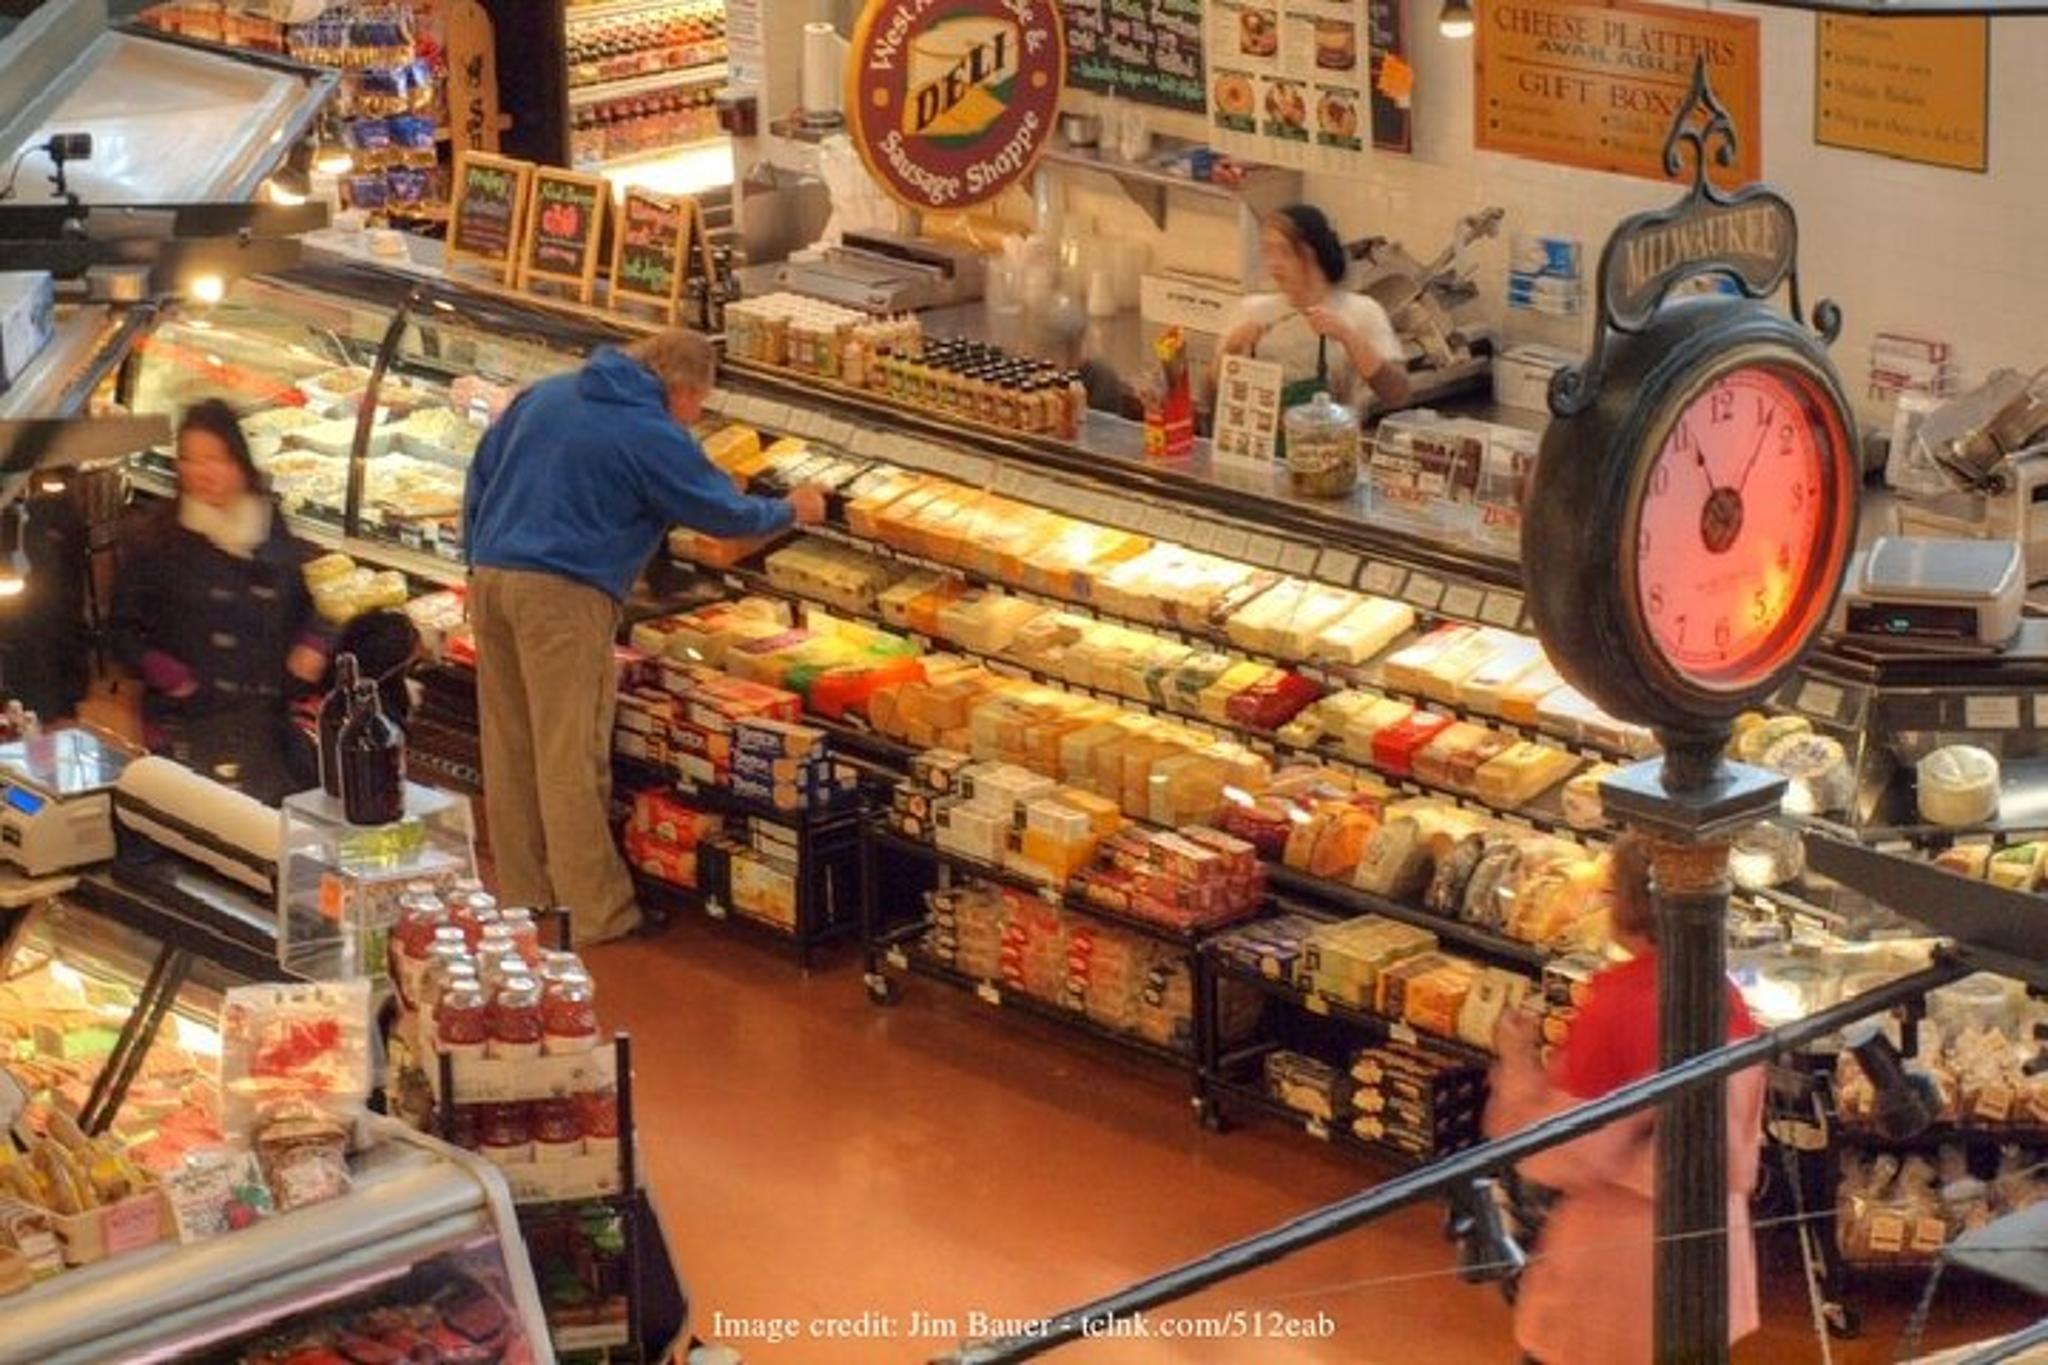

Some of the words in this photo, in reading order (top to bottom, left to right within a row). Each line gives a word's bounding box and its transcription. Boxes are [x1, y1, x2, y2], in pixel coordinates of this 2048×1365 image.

[870, 3, 917, 70] West
[1493, 6, 1592, 43] CHEESE
[1602, 20, 1737, 66] PLATTERS
[916, 31, 1007, 131] DELI
[1518, 71, 1595, 104] GIFT
[877, 130, 960, 204] Sausage
[966, 111, 1039, 193] Shoppe
[1625, 203, 1778, 297] MILWAUKEE
[1710, 388, 1734, 424] 12
